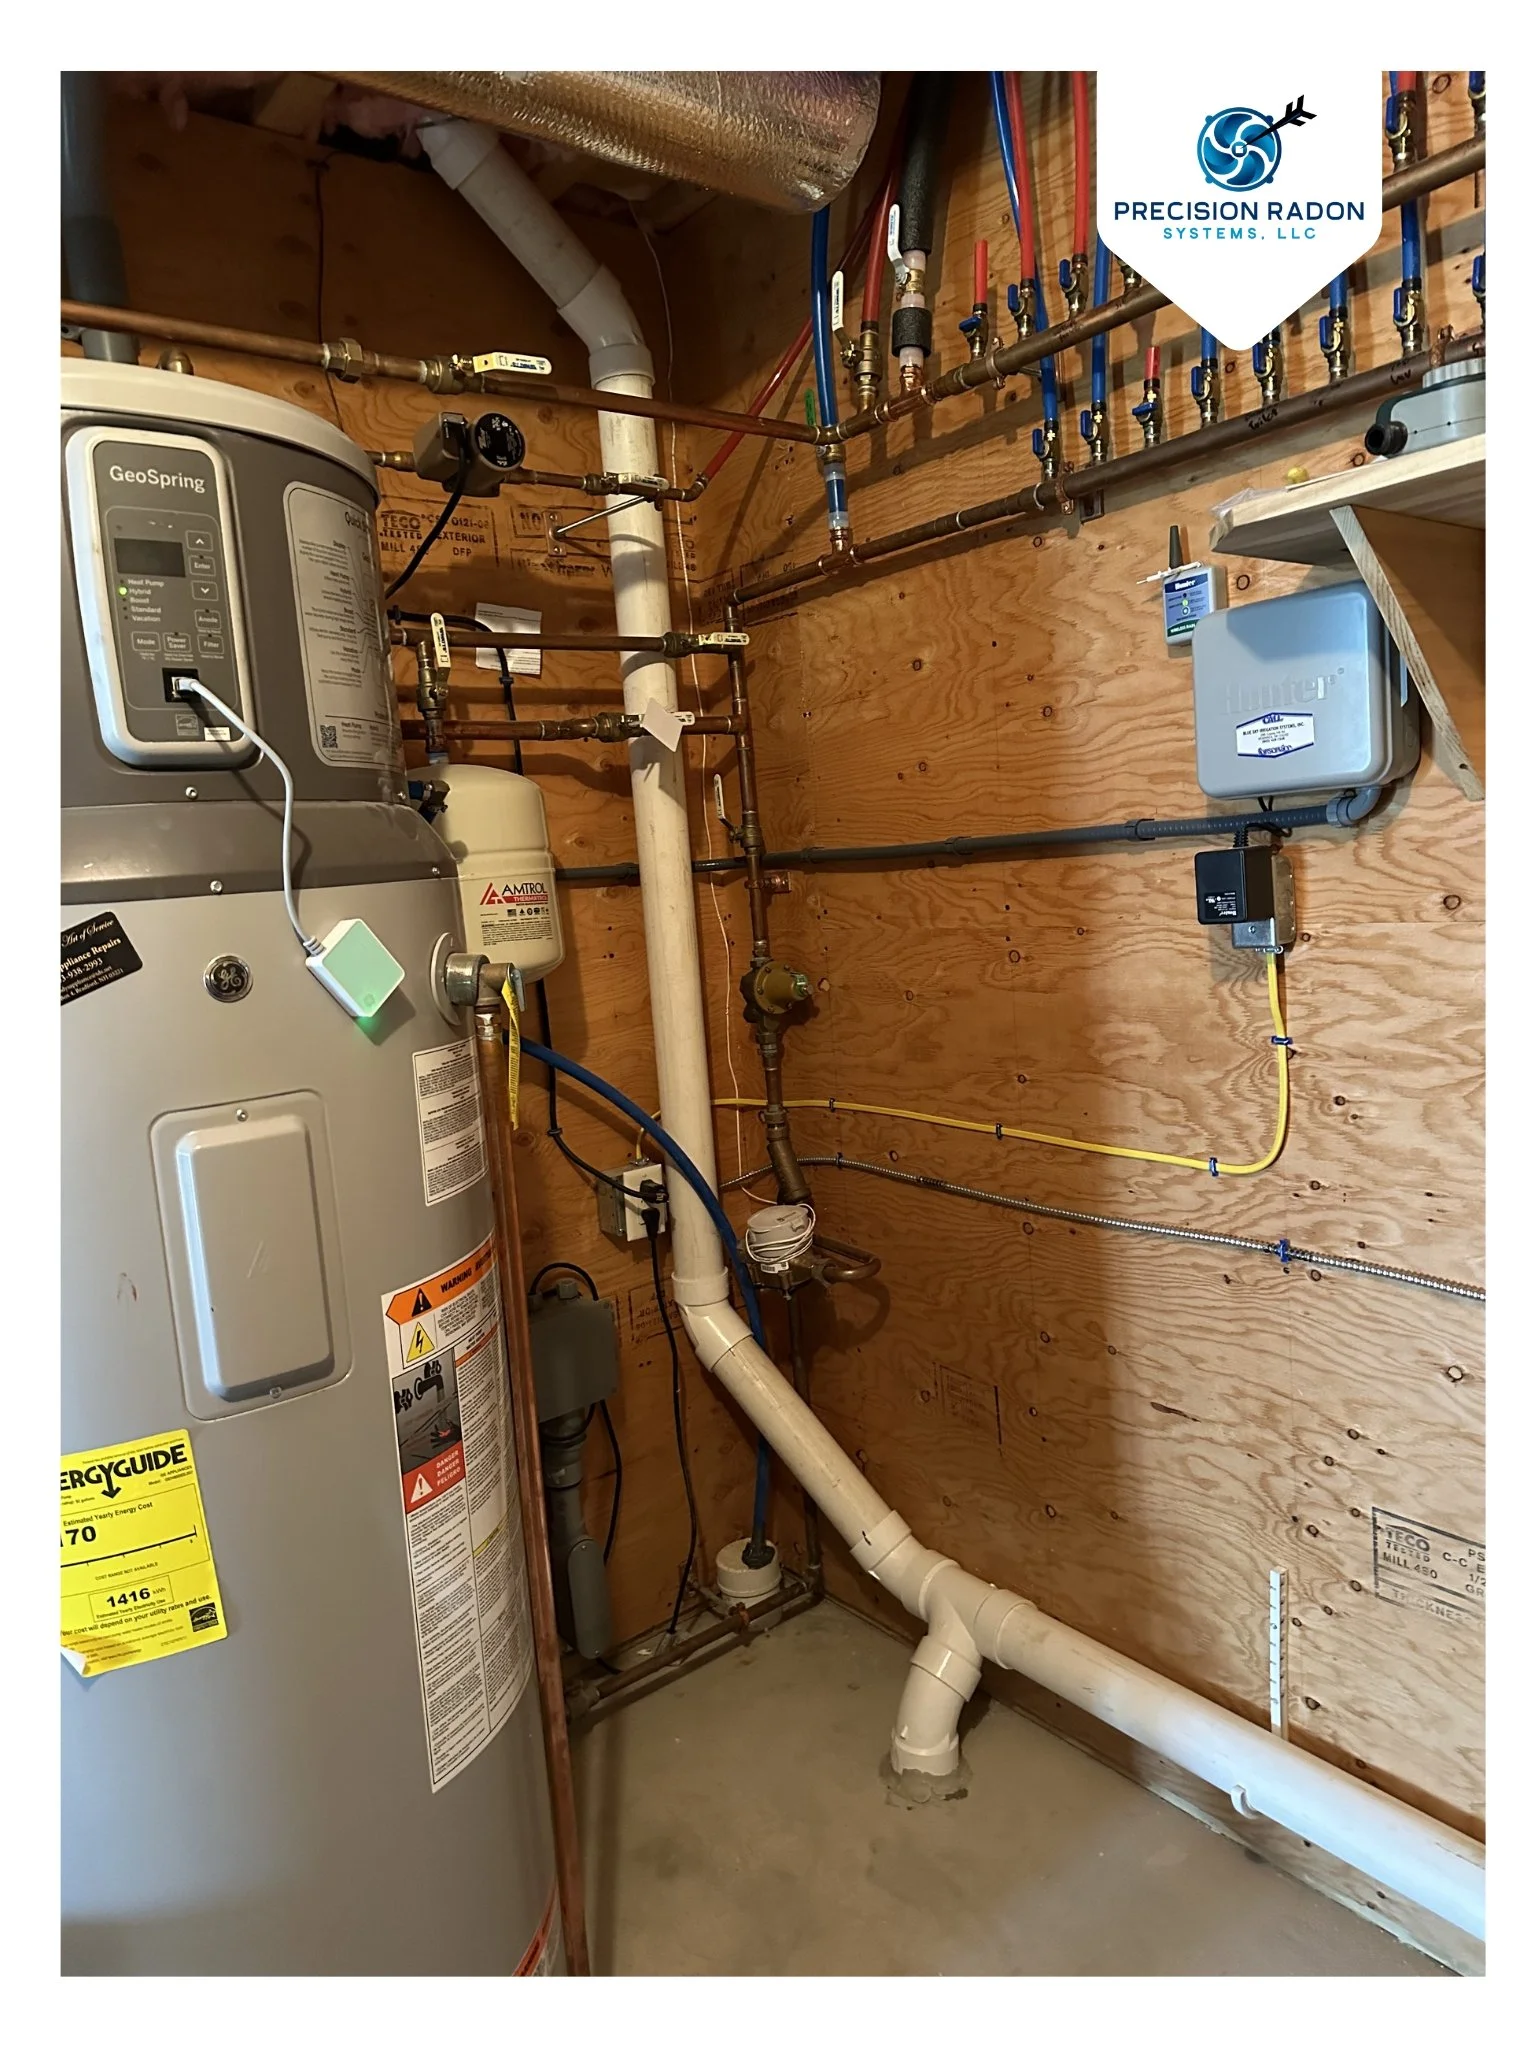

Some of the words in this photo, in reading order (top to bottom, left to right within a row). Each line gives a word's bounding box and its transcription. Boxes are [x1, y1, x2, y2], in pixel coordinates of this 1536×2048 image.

[110, 465, 205, 494] GeoSpring
[381, 514, 420, 530] TECO
[381, 542, 405, 552] MILL
[453, 547, 472, 557] DFP
[129, 588, 152, 596] Hybrid
[145, 580, 164, 588] Pump
[1175, 580, 1196, 590] Hunter
[203, 641, 220, 649] Filter
[502, 882, 548, 896] AMTROL
[80, 928, 86, 942] of
[86, 920, 114, 936] Service
[91, 938, 122, 956] Repairs
[441, 1268, 472, 1293] WARNING
[436, 1450, 459, 1468] DANGER
[437, 1458, 460, 1477] DANGER
[437, 1466, 461, 1486] PELIGRO
[63, 1516, 93, 1526] Estimated
[94, 1512, 114, 1521] Yearly
[114, 1506, 137, 1516] Energy
[138, 1502, 152, 1510] Cost
[1385, 1526, 1430, 1552] TECO
[1442, 1552, 1468, 1568] C-C
[1386, 1542, 1430, 1562] TESTED
[1383, 1552, 1410, 1570] MILL
[106, 1588, 150, 1608] 1416
[152, 1587, 166, 1595] kWh
[96, 1610, 118, 1619] Estimated
[134, 1601, 156, 1611] Electricity
[100, 1618, 124, 1630] depend
[134, 1612, 148, 1622] your
[150, 1608, 168, 1618] utility
[168, 1604, 184, 1612] rates
[198, 1594, 212, 1602] use.
